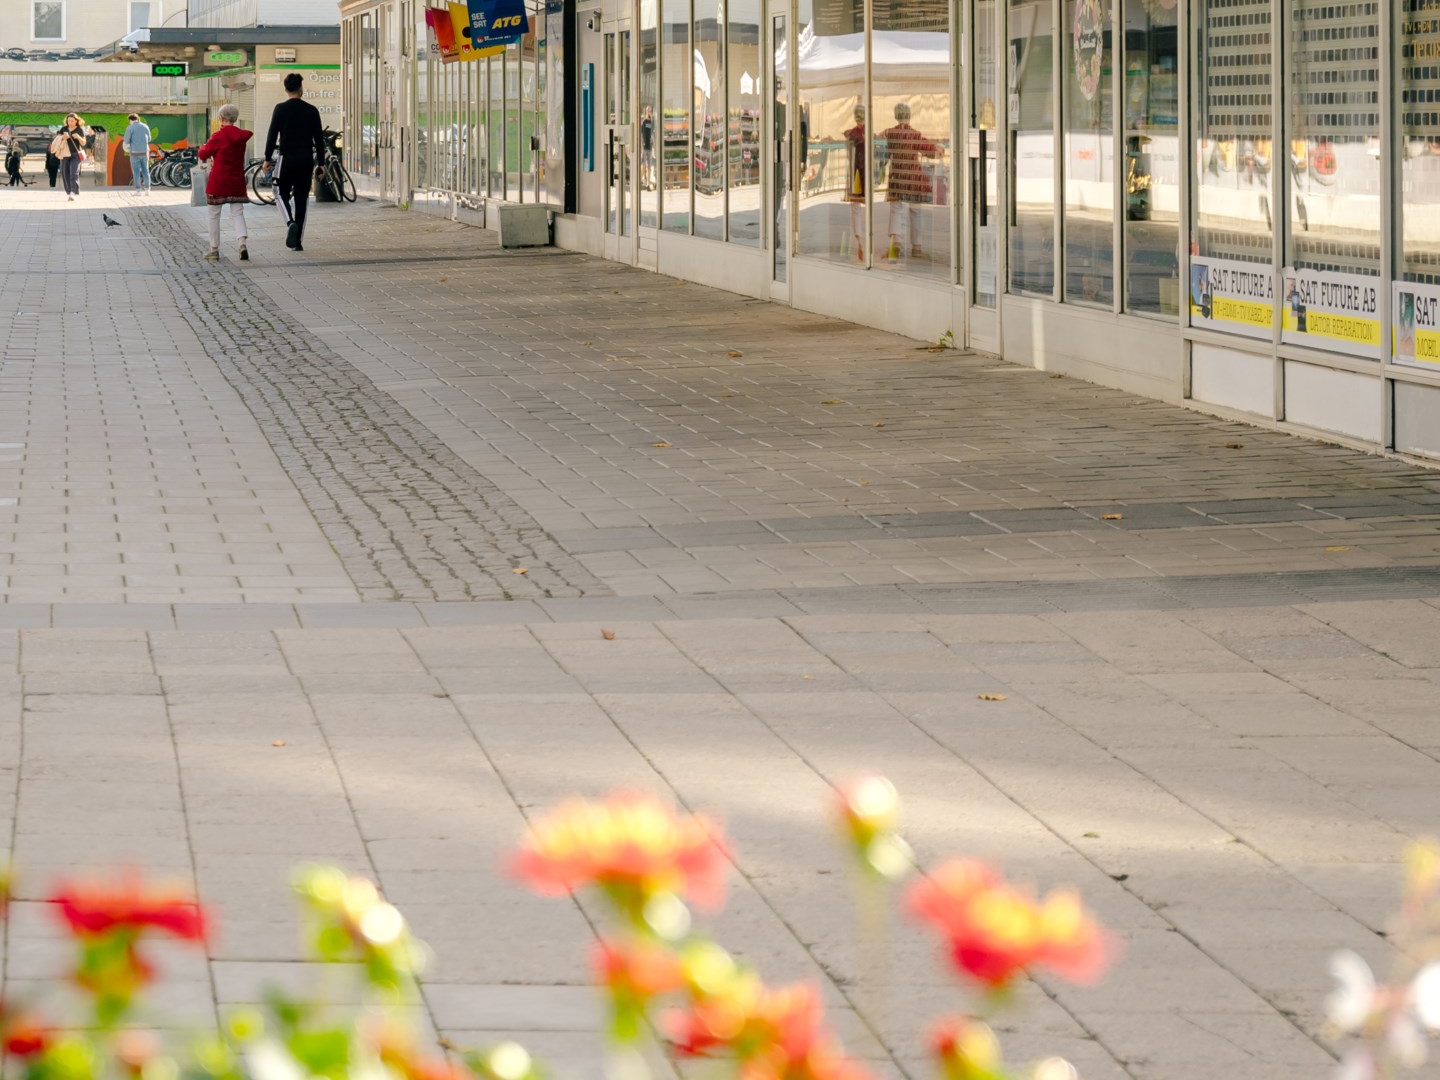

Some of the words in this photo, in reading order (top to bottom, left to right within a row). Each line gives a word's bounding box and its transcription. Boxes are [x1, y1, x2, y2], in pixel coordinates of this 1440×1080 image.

[471, 12, 485, 21] SEE
[491, 15, 522, 30] ATG
[473, 20, 487, 28] SAT
[209, 52, 244, 63] coop
[155, 66, 182, 75] coop
[302, 87, 334, 98] ån-fre
[1212, 268, 1228, 292] SAT
[1231, 271, 1265, 298] FUTURE
[1299, 279, 1318, 304] SAT
[1321, 282, 1361, 311] FUTURE
[1363, 287, 1376, 313] AB
[1415, 295, 1438, 327] SAT
[1309, 315, 1331, 333] DATOR
[1332, 317, 1373, 340] REPARATION
